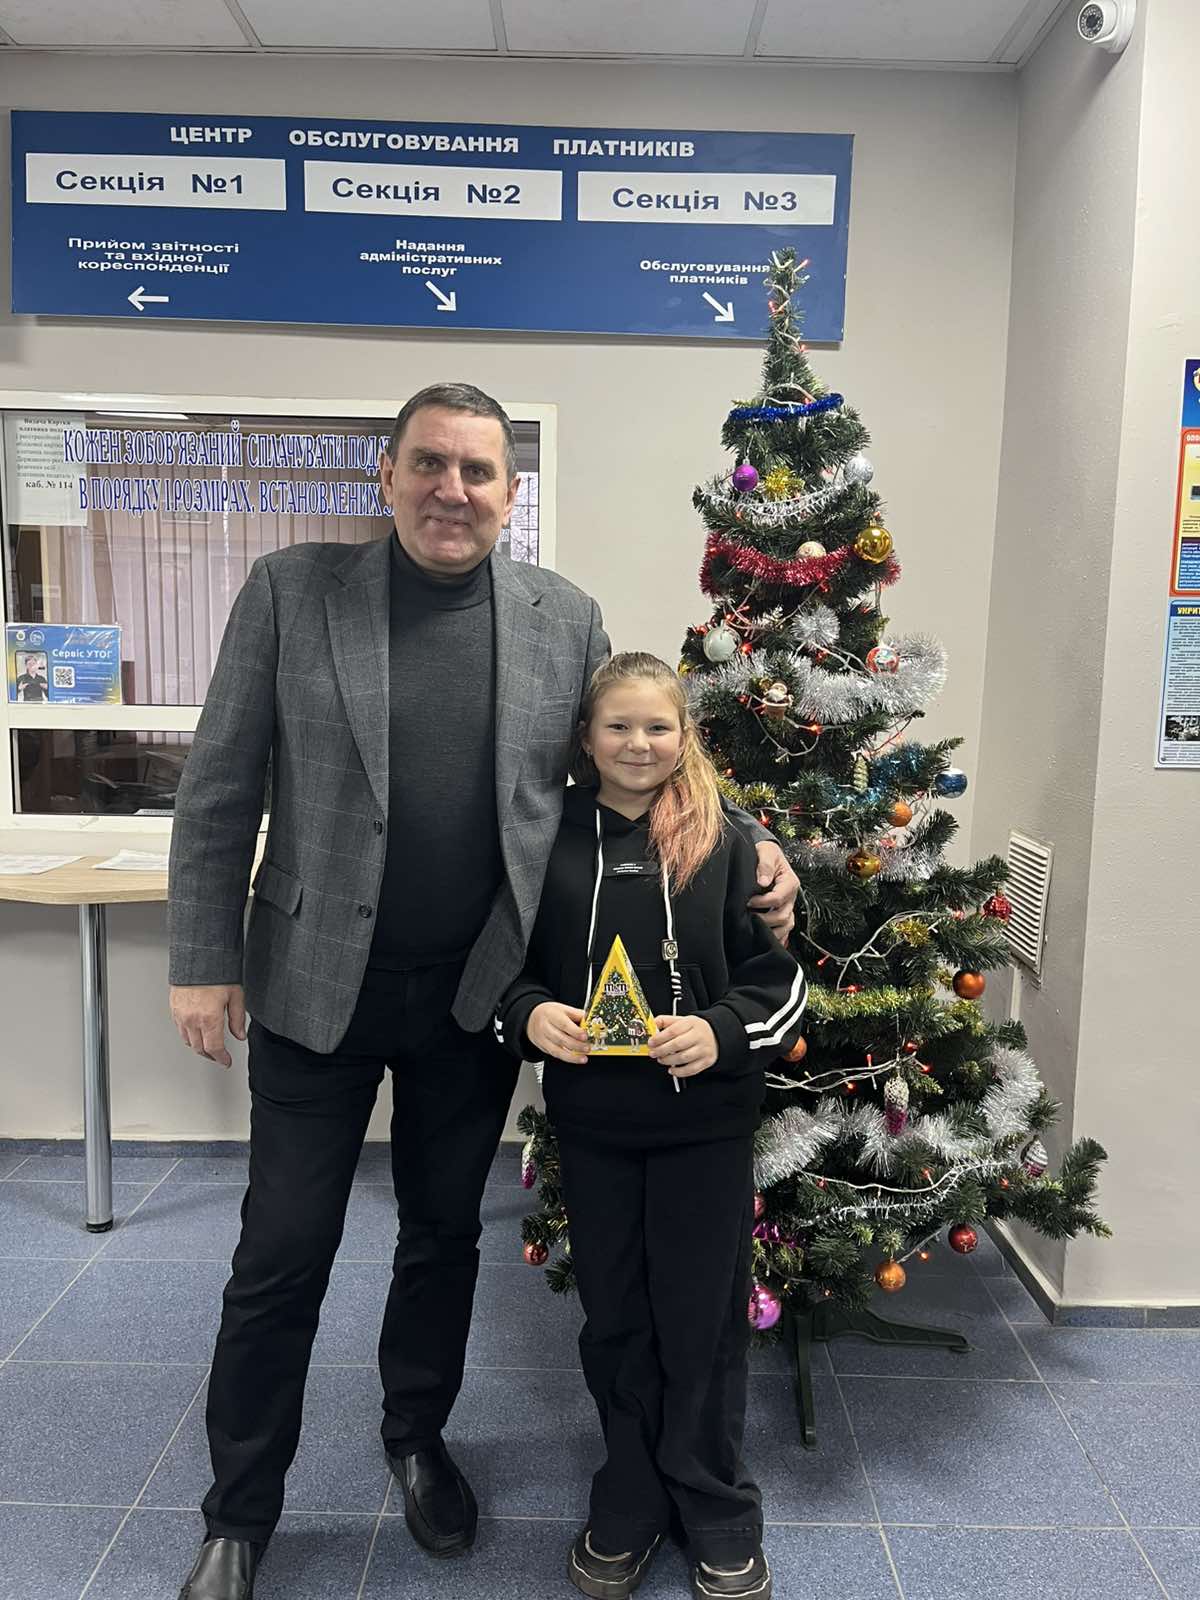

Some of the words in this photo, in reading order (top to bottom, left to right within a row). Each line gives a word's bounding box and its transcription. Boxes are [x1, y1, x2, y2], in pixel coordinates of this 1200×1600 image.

[170, 126, 253, 145] ЦЕНТР
[288, 129, 519, 154] ОБСЛУГОВУВАННЯ
[552, 139, 695, 158] ПЛАТНИКІВ
[55, 170, 165, 194] Секція
[191, 173, 243, 194] №1
[331, 177, 440, 203] Секція
[467, 183, 521, 205] №2
[612, 187, 719, 212] Секція
[744, 191, 798, 211] №3
[68, 238, 146, 251] Прийом
[151, 240, 239, 254] звітності
[395, 240, 465, 253] Надання
[104, 251, 126, 261] та
[131, 251, 204, 263] вхідної
[359, 250, 502, 266] адміністративних
[77, 259, 230, 274] кореспонденції
[402, 265, 457, 278] послуг
[639, 259, 770, 274] Обслуговування
[669, 273, 748, 285] платників
[63, 430, 121, 463] КОЖЕН
[124, 419, 242, 466] ЗОБОВ'ЯЗАНИЙ
[248, 433, 344, 469] СПЛАЧУВАТИ
[59, 481, 73, 489] 114
[79, 477, 88, 510] В
[91, 478, 160, 516] ПОРЯДКУ
[259, 481, 382, 516] ВСТАНОВЛЕНИХ
[52, 649, 84, 658] Сервіс
[86, 650, 112, 658] УТОГ
